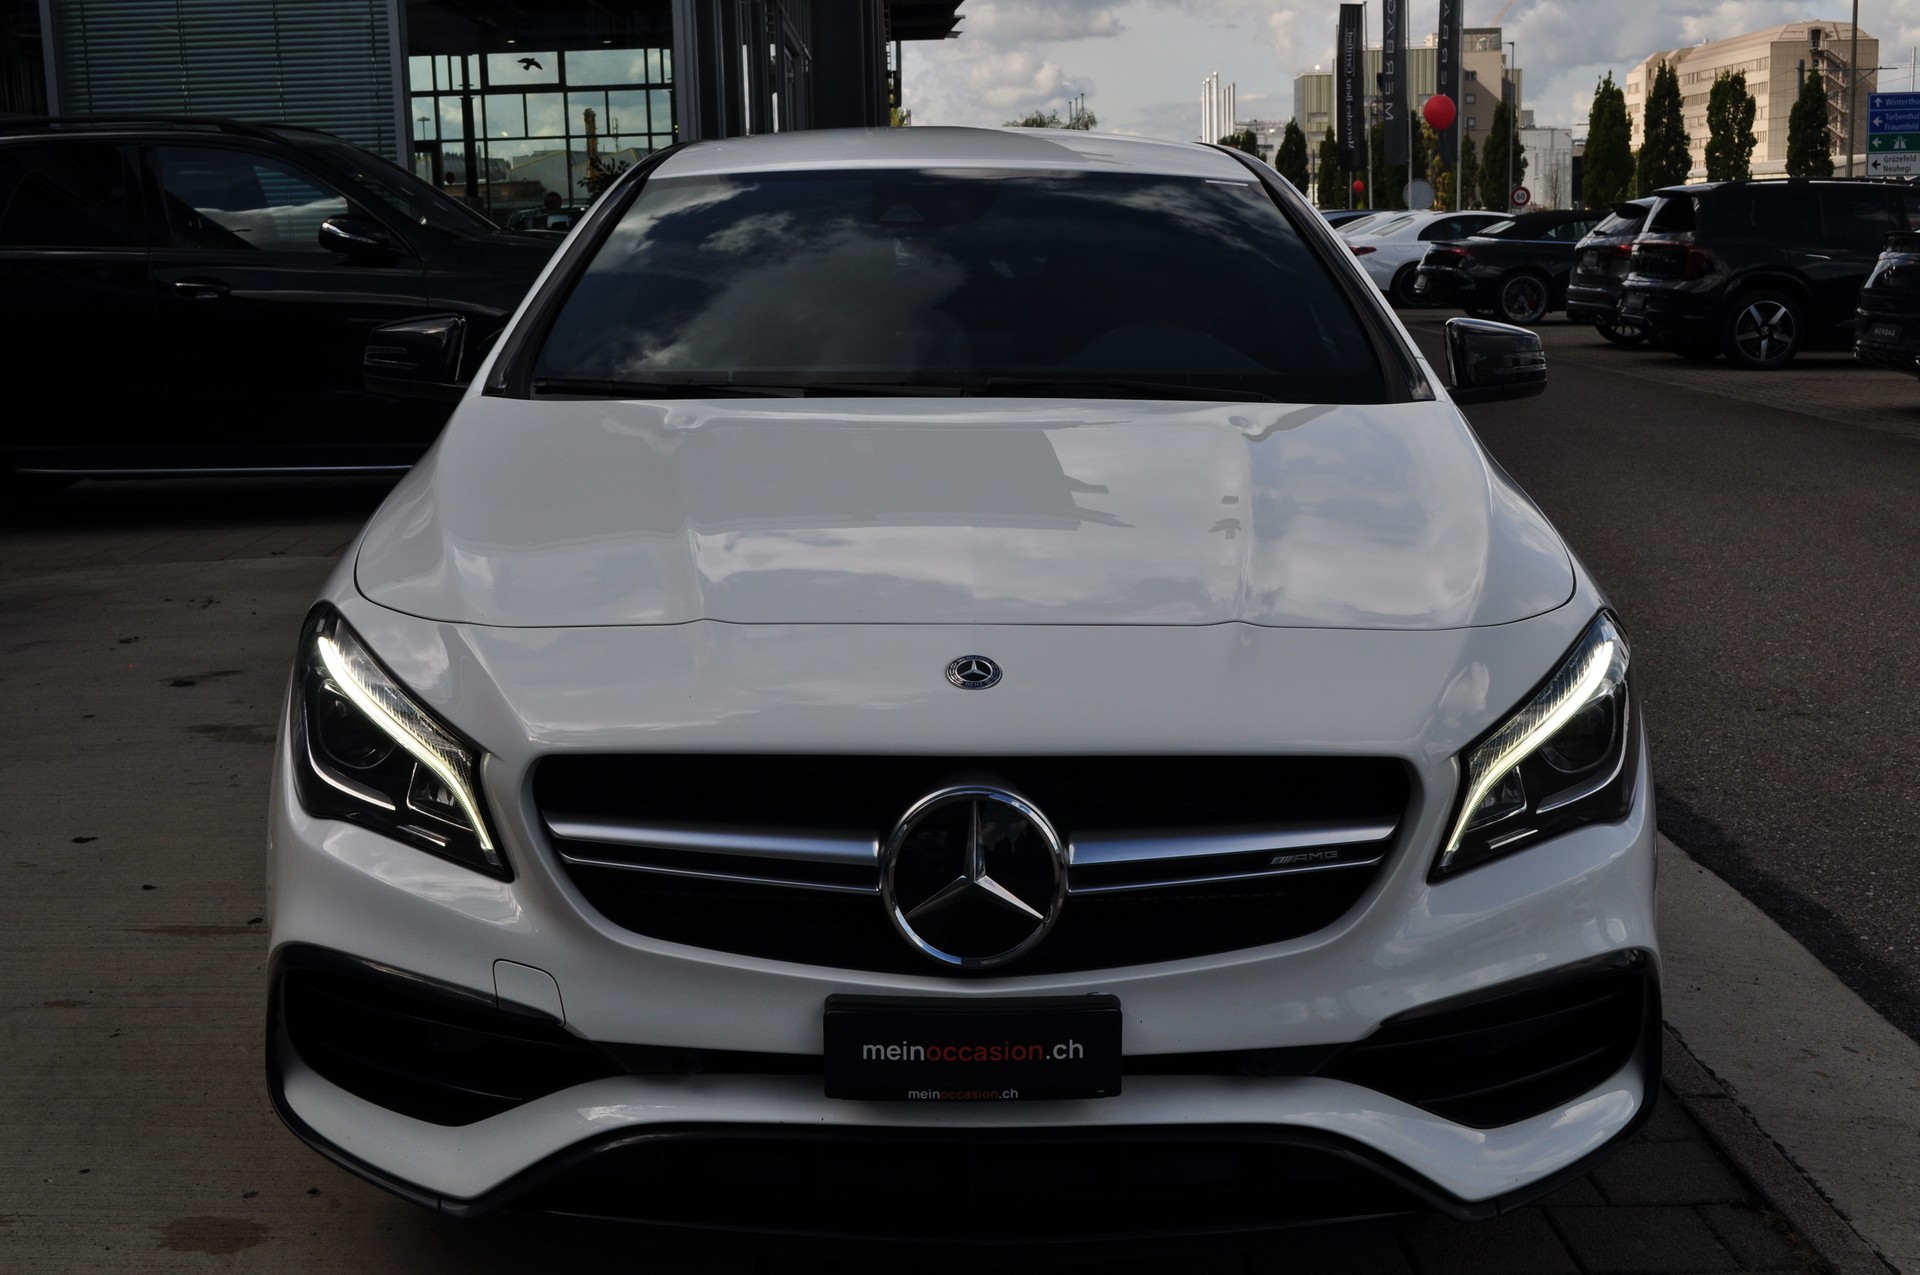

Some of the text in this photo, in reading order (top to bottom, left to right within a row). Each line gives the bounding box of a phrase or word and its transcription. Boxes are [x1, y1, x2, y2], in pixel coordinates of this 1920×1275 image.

[1885, 112, 1920, 120] Turbenthal
[1884, 122, 1919, 131] Frauenfeld
[1883, 154, 1917, 163] Grüzefeld
[1883, 164, 1912, 173] Neuhegi
[1516, 192, 1525, 201] 60
[863, 1040, 1084, 1063] meinoccasion.ch
[908, 1088, 1019, 1100] meinoccasion.ch
